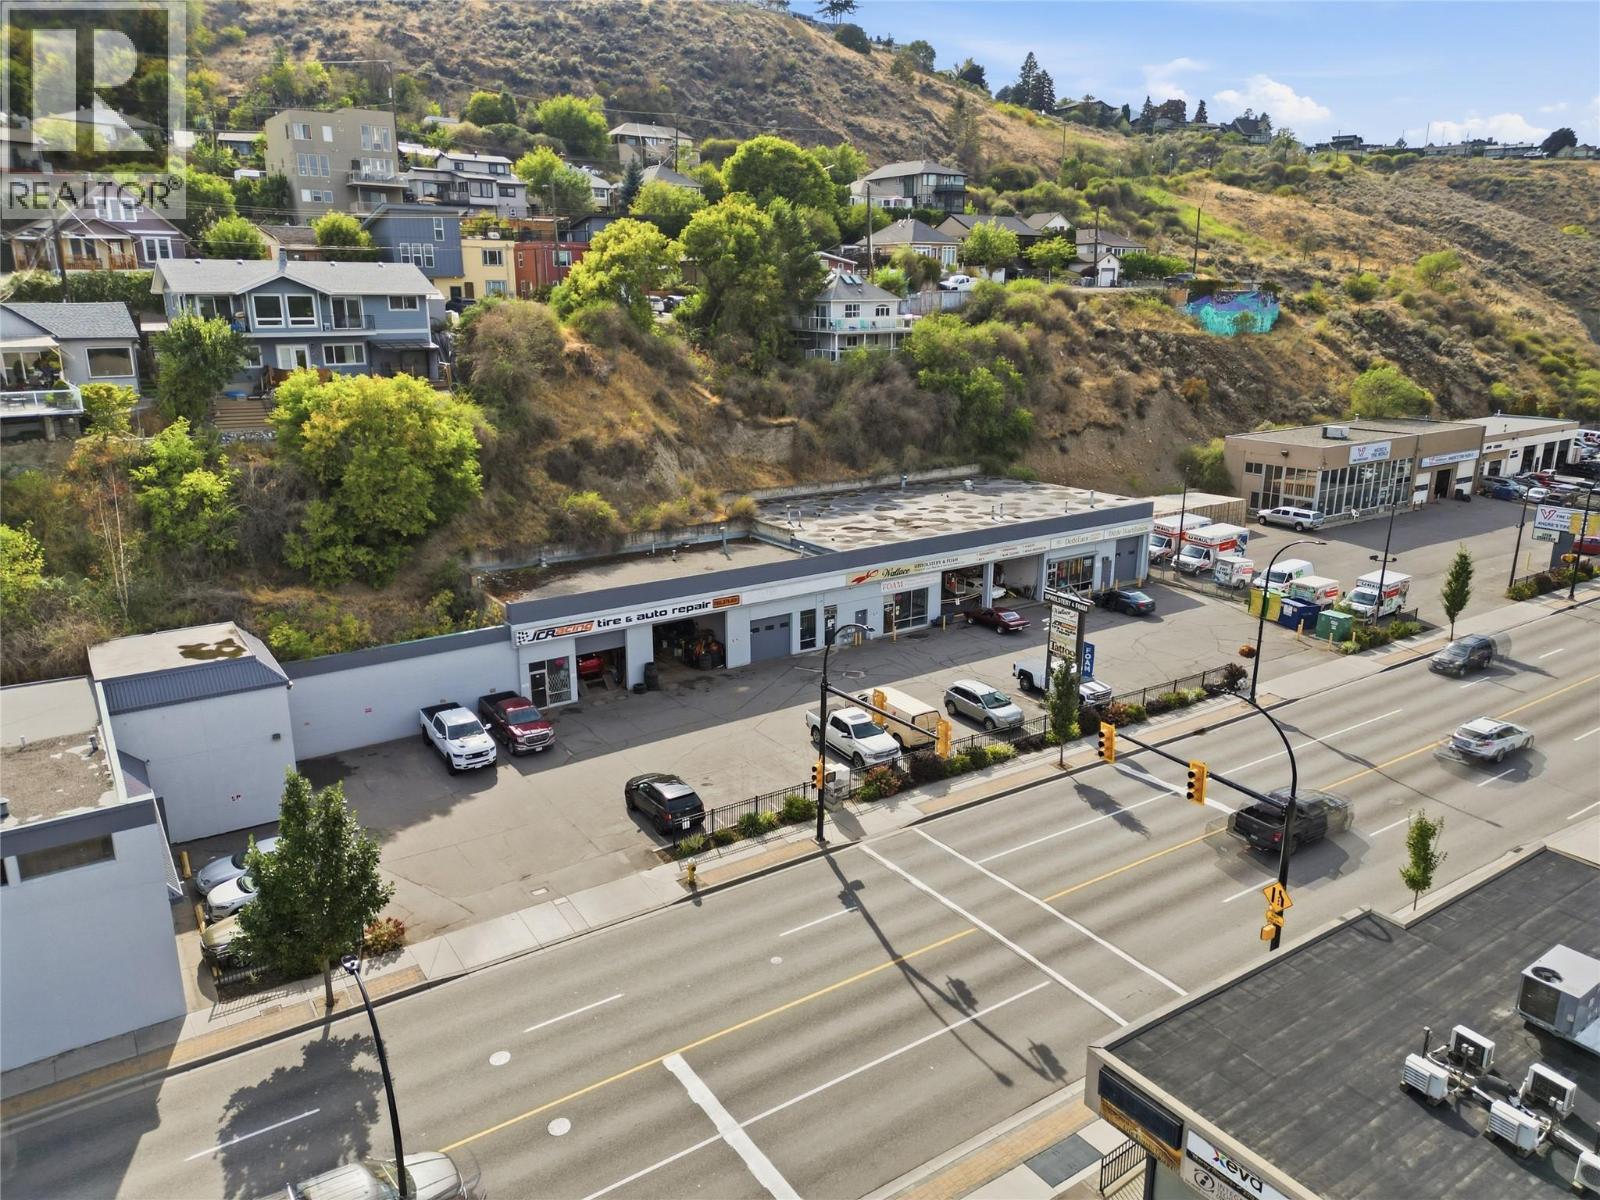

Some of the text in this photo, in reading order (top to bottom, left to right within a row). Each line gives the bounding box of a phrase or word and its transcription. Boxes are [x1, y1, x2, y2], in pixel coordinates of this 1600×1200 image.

[597, 616, 622, 627] tire
[636, 608, 668, 621] auto
[671, 601, 711, 615] repair
[1050, 641, 1076, 657] Tattoo
